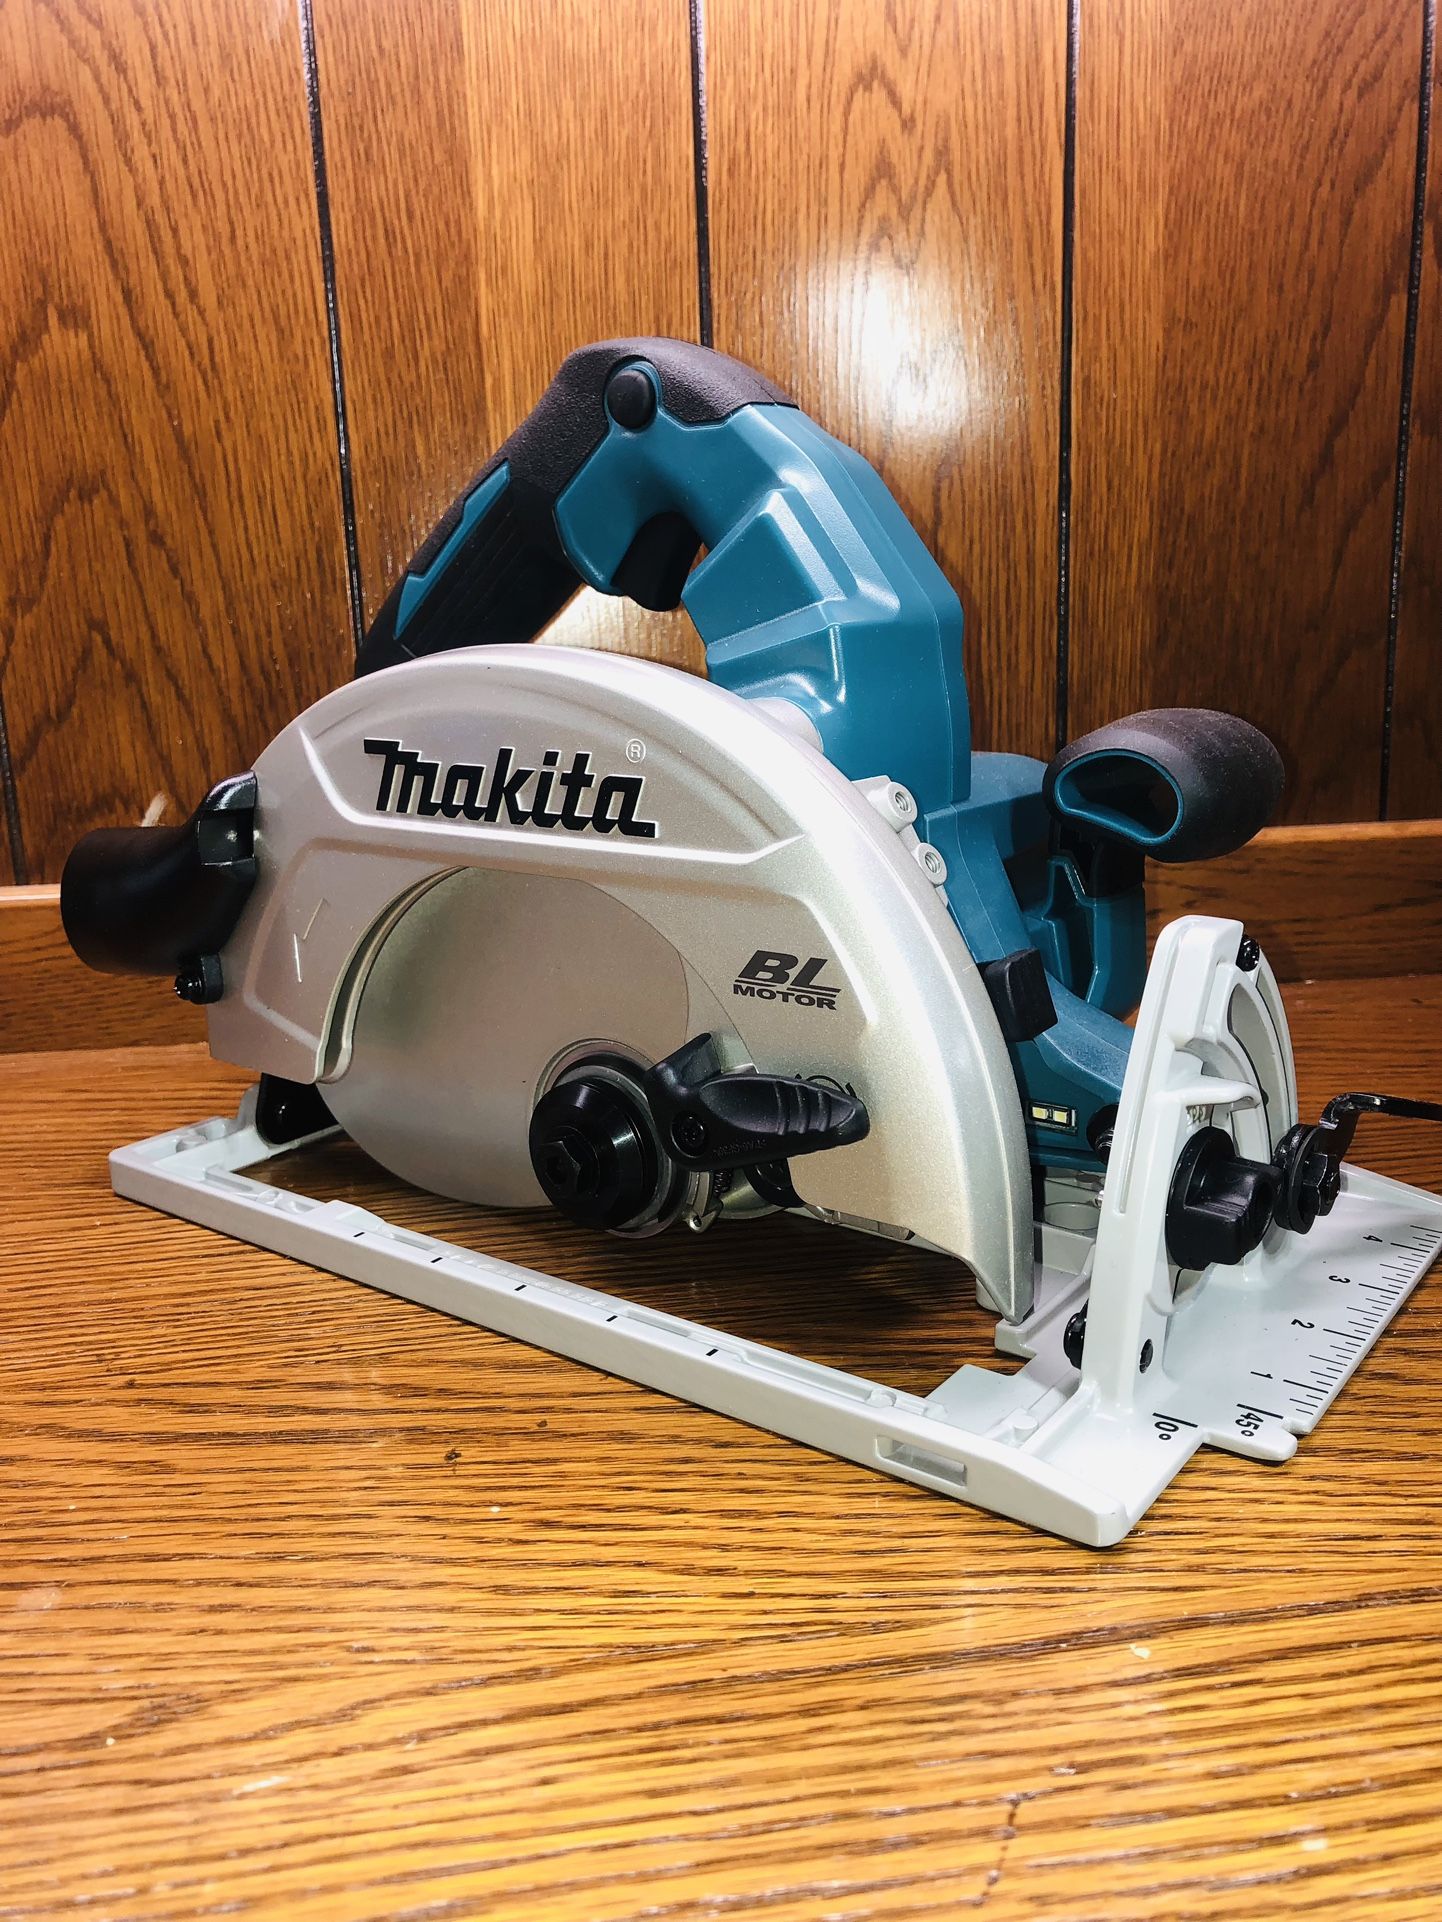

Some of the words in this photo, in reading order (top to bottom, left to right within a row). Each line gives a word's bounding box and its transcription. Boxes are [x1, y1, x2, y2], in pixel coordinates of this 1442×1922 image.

[738, 950, 841, 993] BL
[733, 983, 837, 1011] MOTOR
[1362, 1234, 1383, 1243] 4
[1328, 1274, 1351, 1284] 3
[1290, 1318, 1315, 1329] 2
[1250, 1371, 1273, 1379] 1
